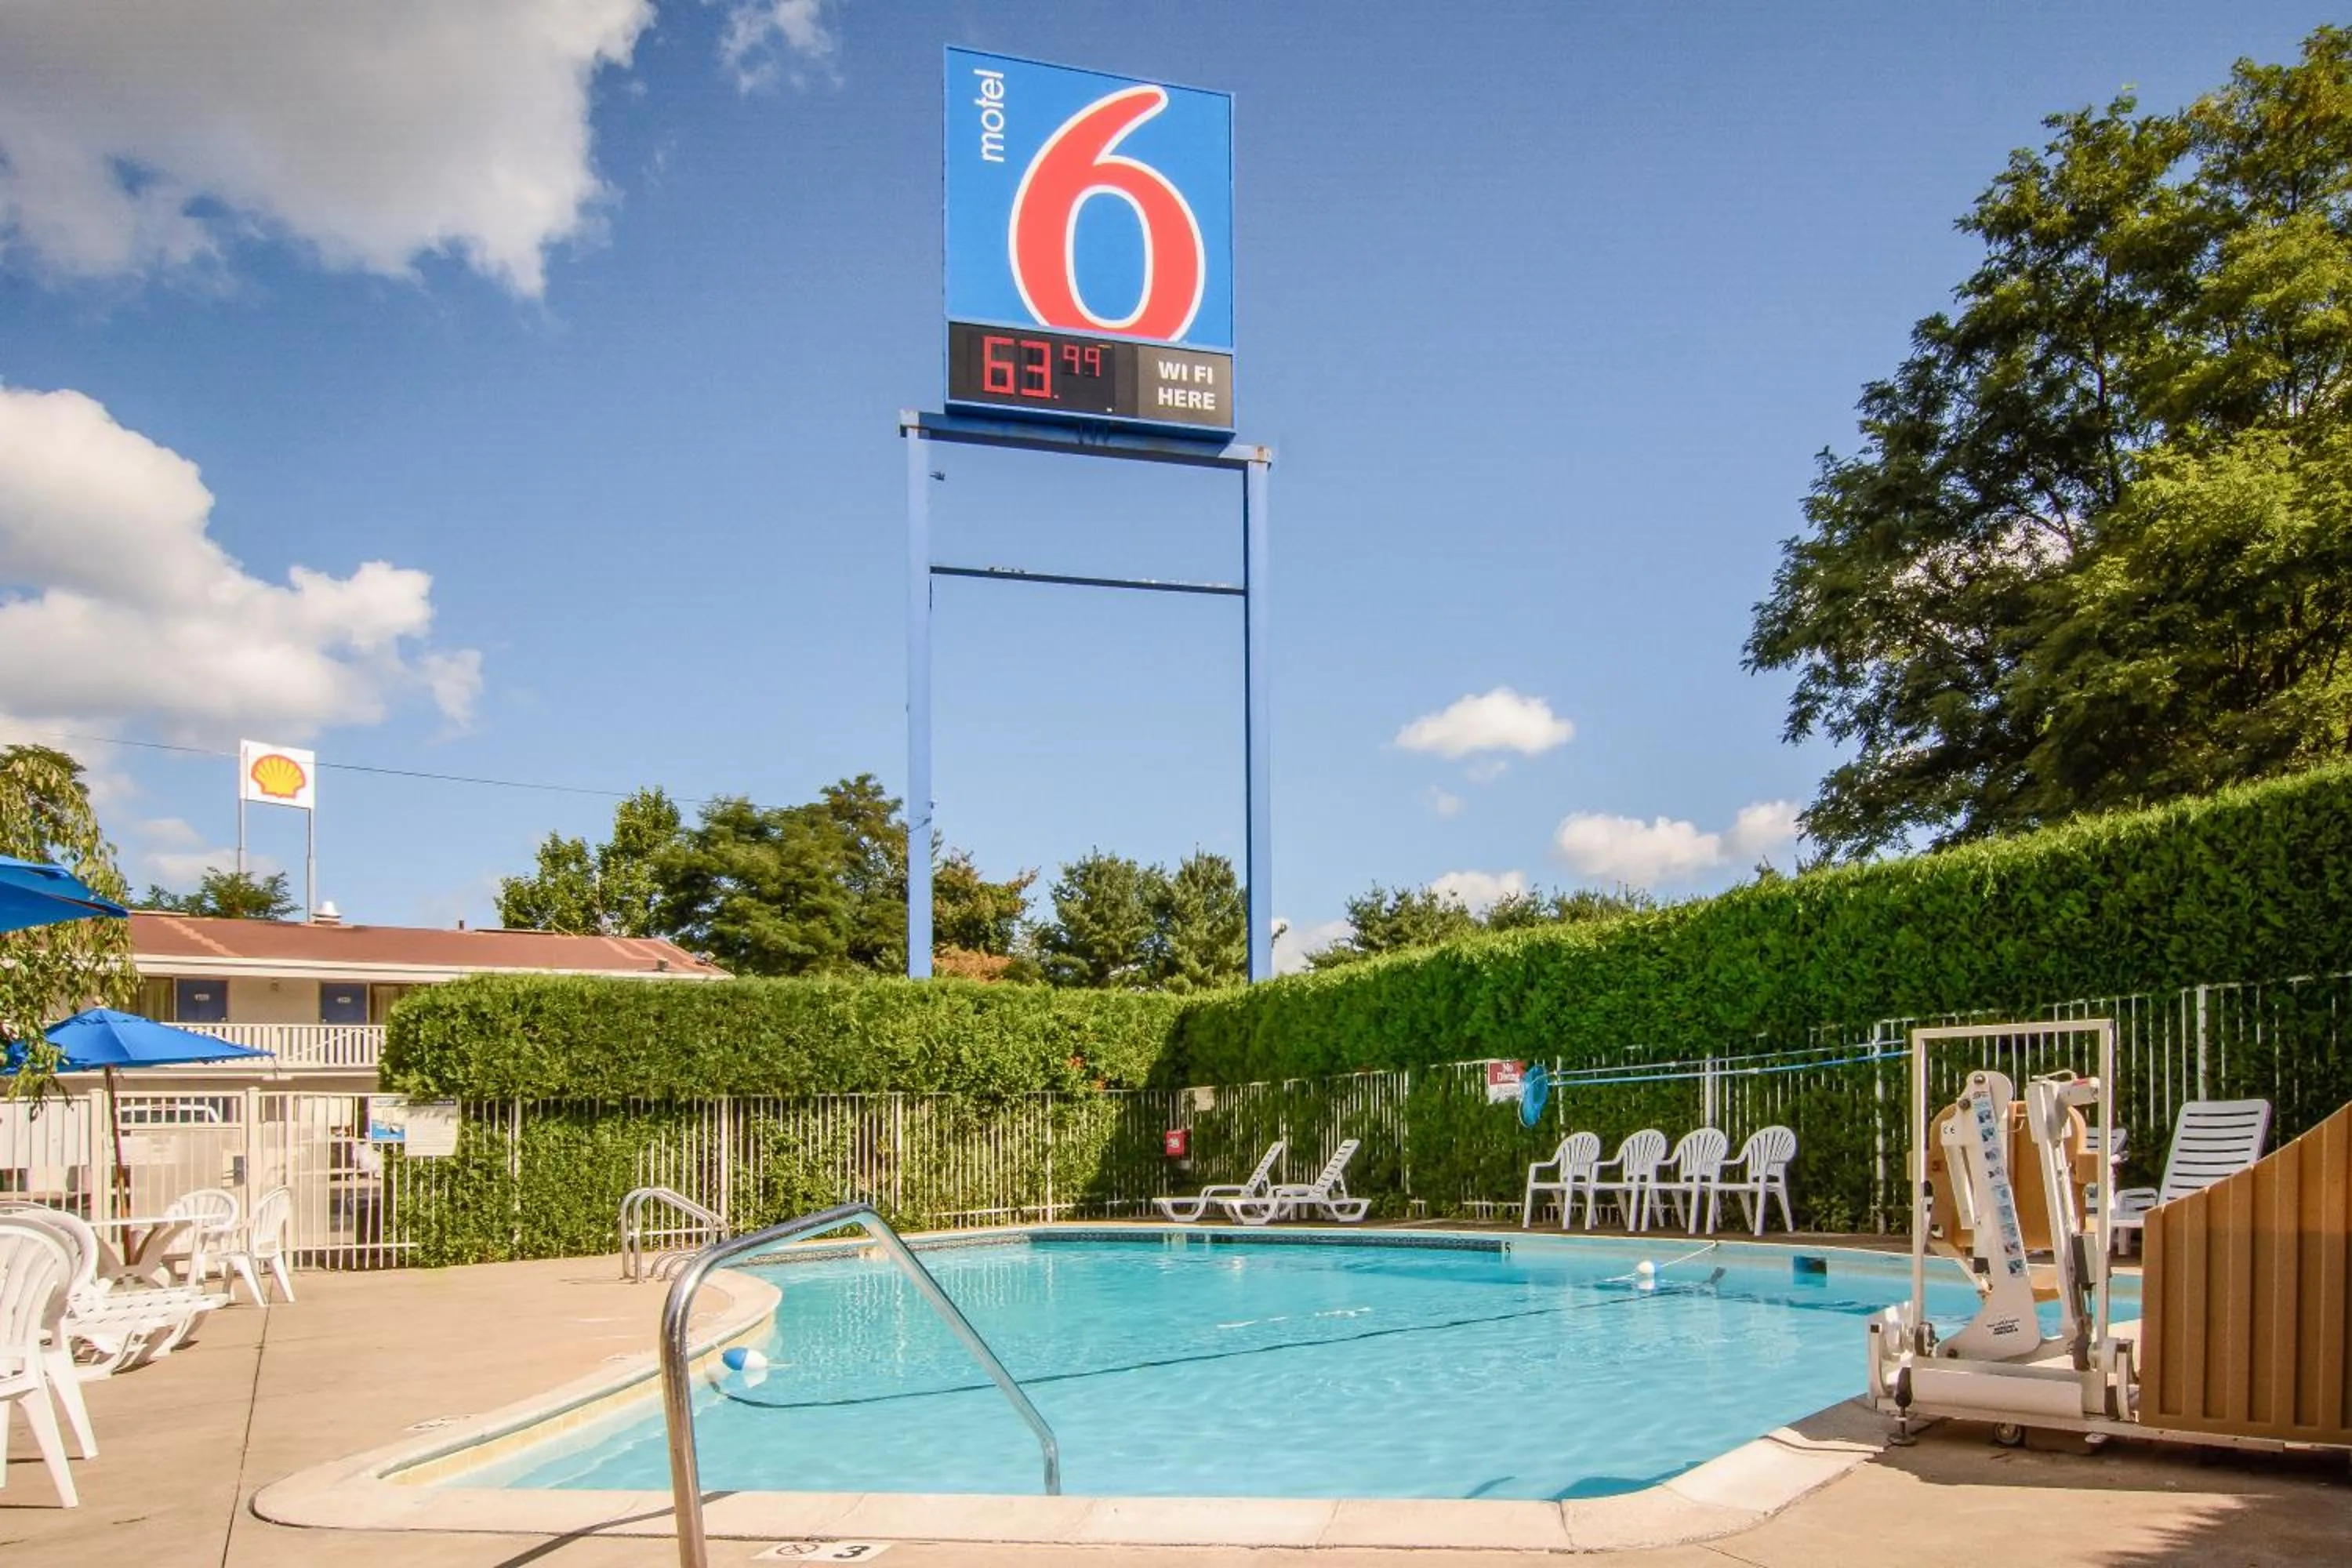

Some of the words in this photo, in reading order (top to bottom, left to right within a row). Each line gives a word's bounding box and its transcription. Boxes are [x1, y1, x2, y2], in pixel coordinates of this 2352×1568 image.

[973, 68, 1004, 162] motel
[1009, 85, 1205, 341] 6
[1158, 360, 1188, 383] WI
[1194, 365, 1213, 384] FI
[1158, 387, 1216, 411] HERE
[833, 1545, 870, 1559] 3
